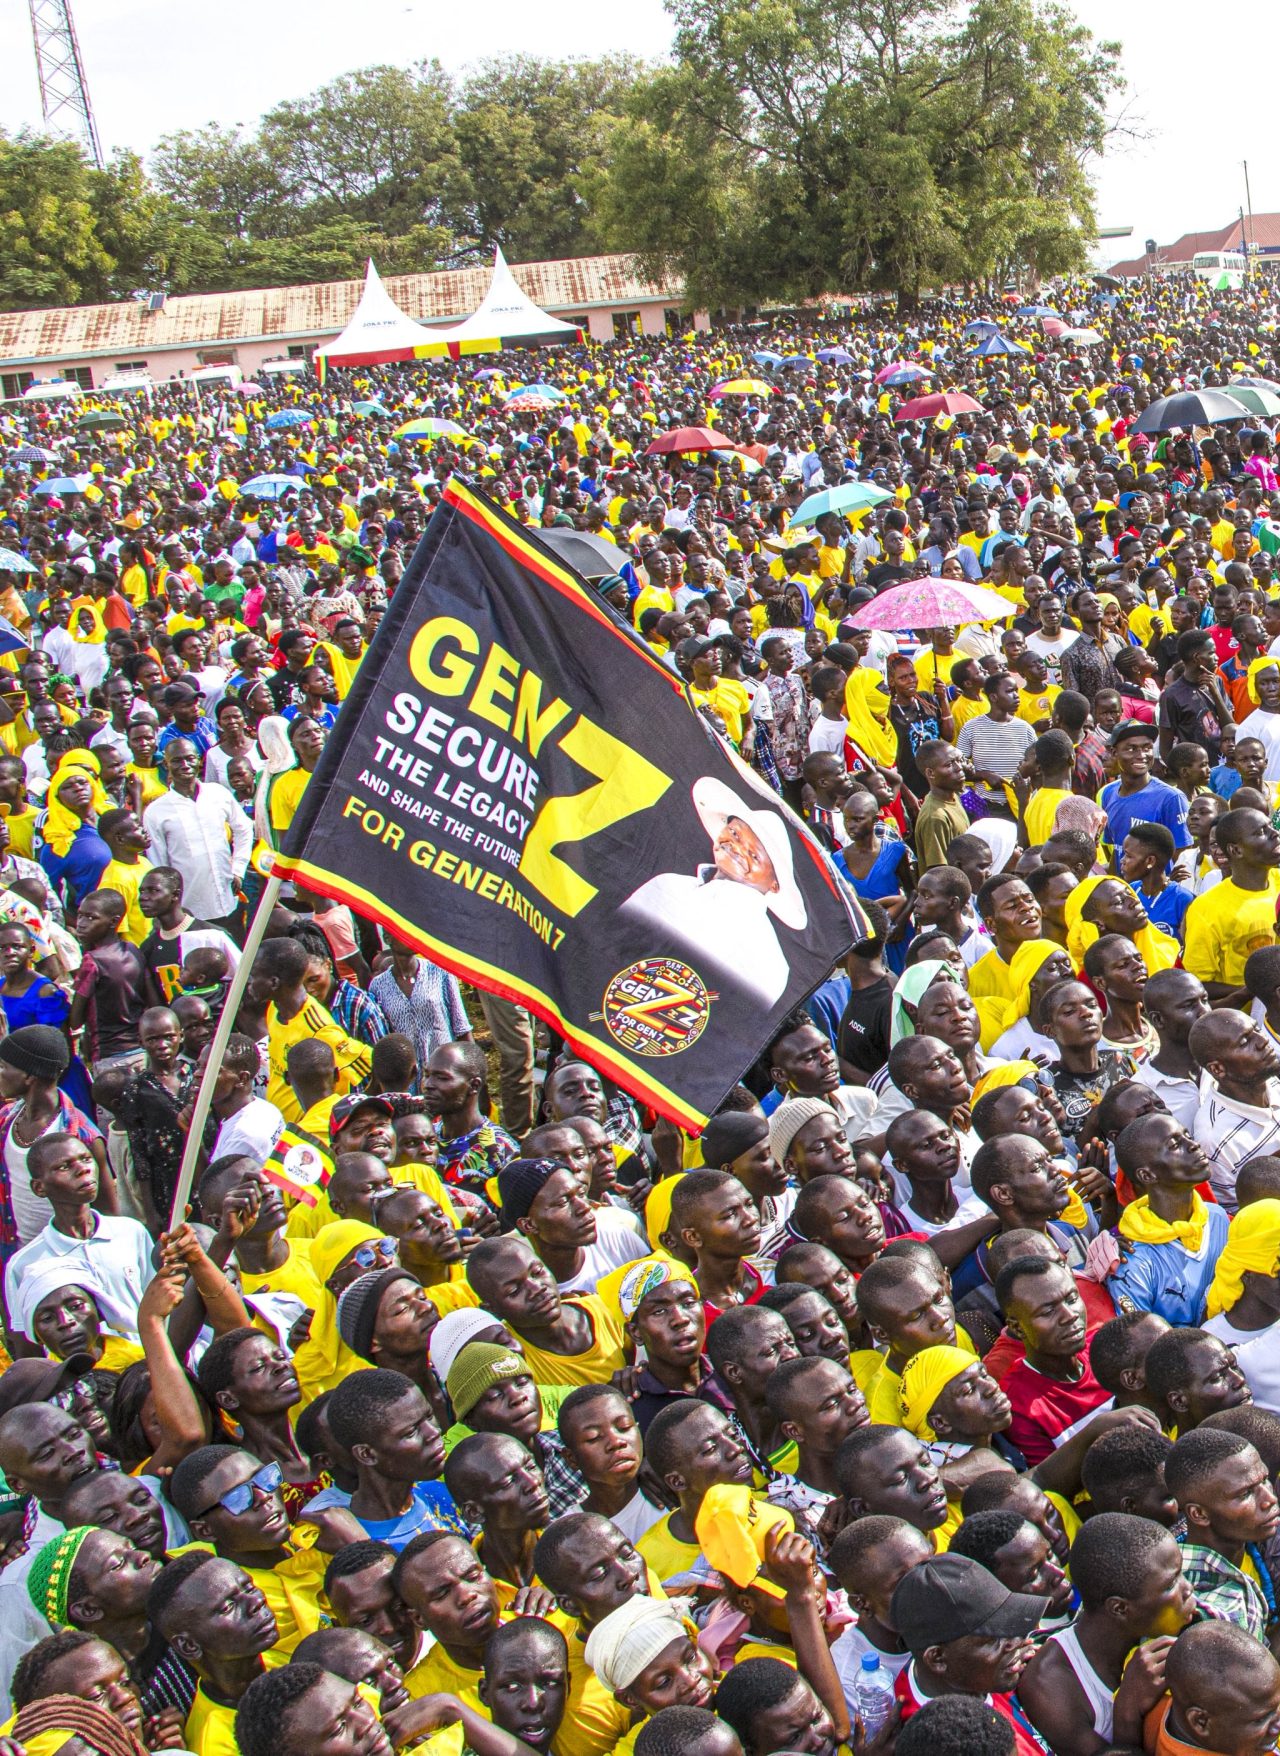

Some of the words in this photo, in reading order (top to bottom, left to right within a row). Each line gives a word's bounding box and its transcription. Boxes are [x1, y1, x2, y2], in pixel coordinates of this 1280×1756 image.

[374, 736, 433, 787] THE
[433, 772, 530, 841] LEGACY
[385, 693, 540, 811] SECURE
[408, 616, 572, 759] GEN
[518, 714, 674, 918] Z
[358, 769, 390, 797] AND
[390, 789, 442, 826] SHAPE
[443, 816, 474, 843] THE
[474, 832, 521, 869] FUTURE
[342, 795, 405, 851] FOR
[408, 840, 558, 945] GENERATION
[552, 927, 566, 951] 7
[616, 1012, 636, 1028] FOR
[636, 1021, 658, 1039] GEN
[657, 1033, 665, 1043] 7
[620, 979, 664, 1001] GEN
